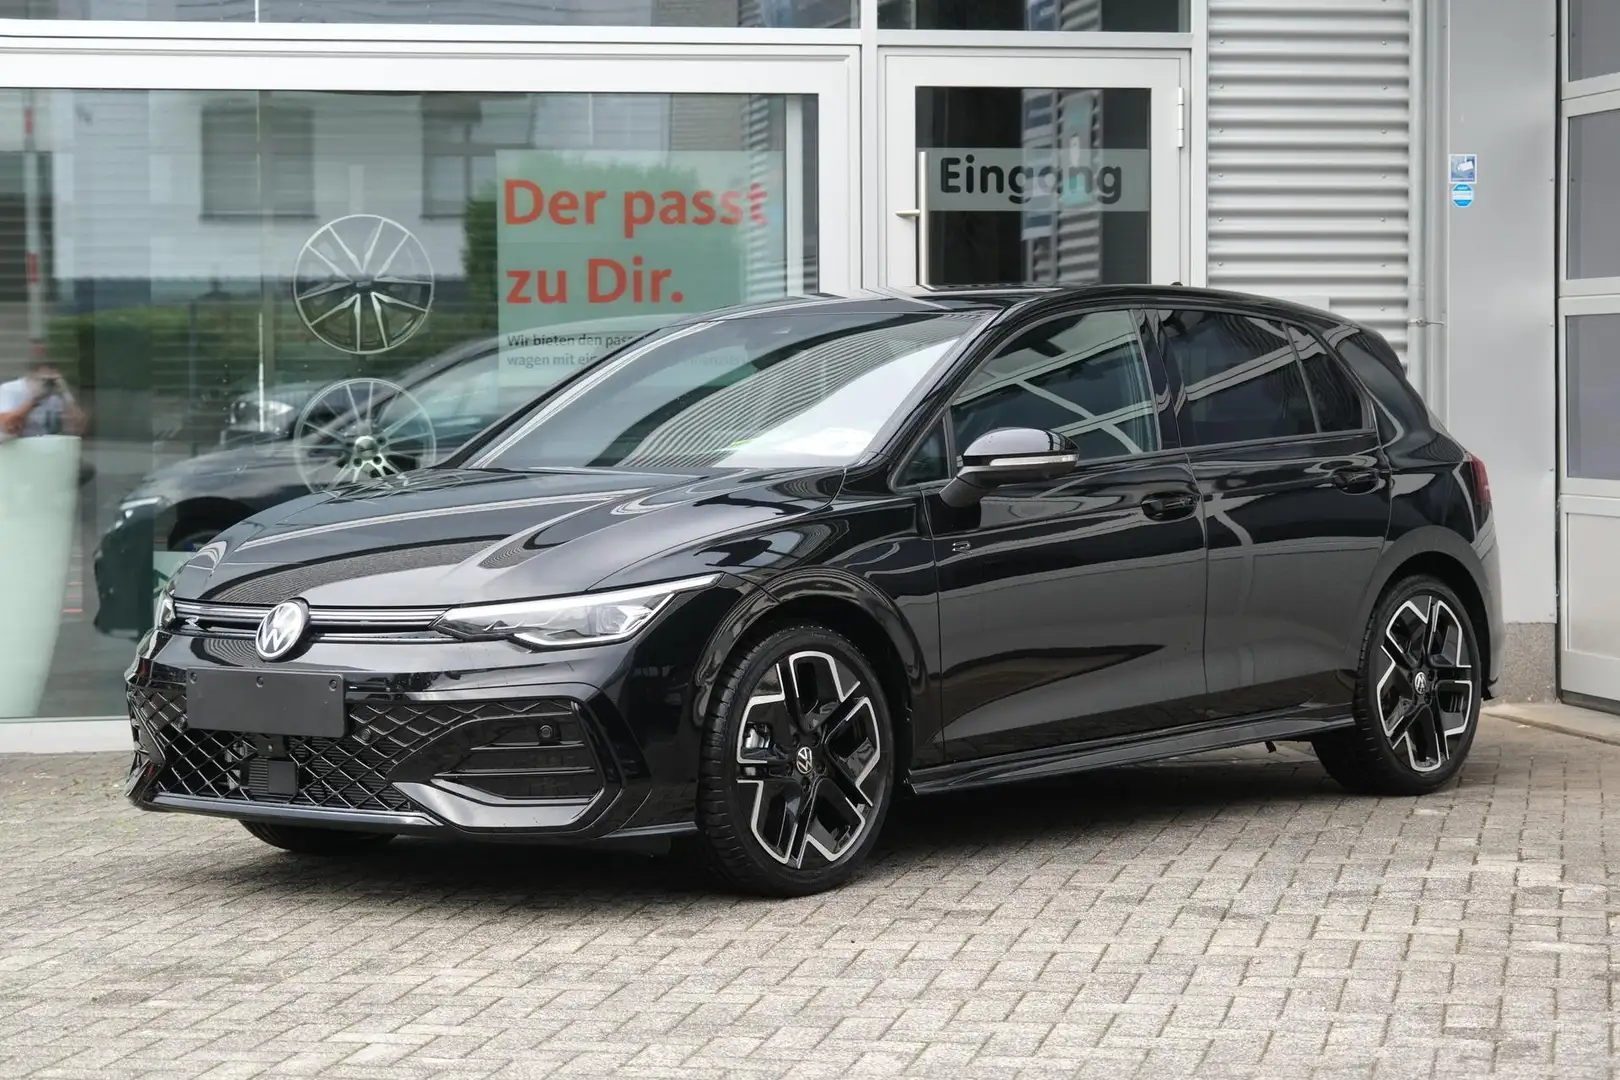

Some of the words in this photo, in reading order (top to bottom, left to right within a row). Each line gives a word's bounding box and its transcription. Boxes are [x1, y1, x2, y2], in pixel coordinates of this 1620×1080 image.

[940, 154, 1122, 204] Eingang
[505, 179, 607, 225] Der
[624, 183, 768, 238] passt
[506, 270, 567, 304] zu
[587, 255, 684, 304] Dir.
[507, 335, 529, 347] Wir
[533, 333, 575, 346] bieten
[578, 333, 602, 346] den
[507, 354, 550, 368] wagen
[553, 352, 575, 365] mit
